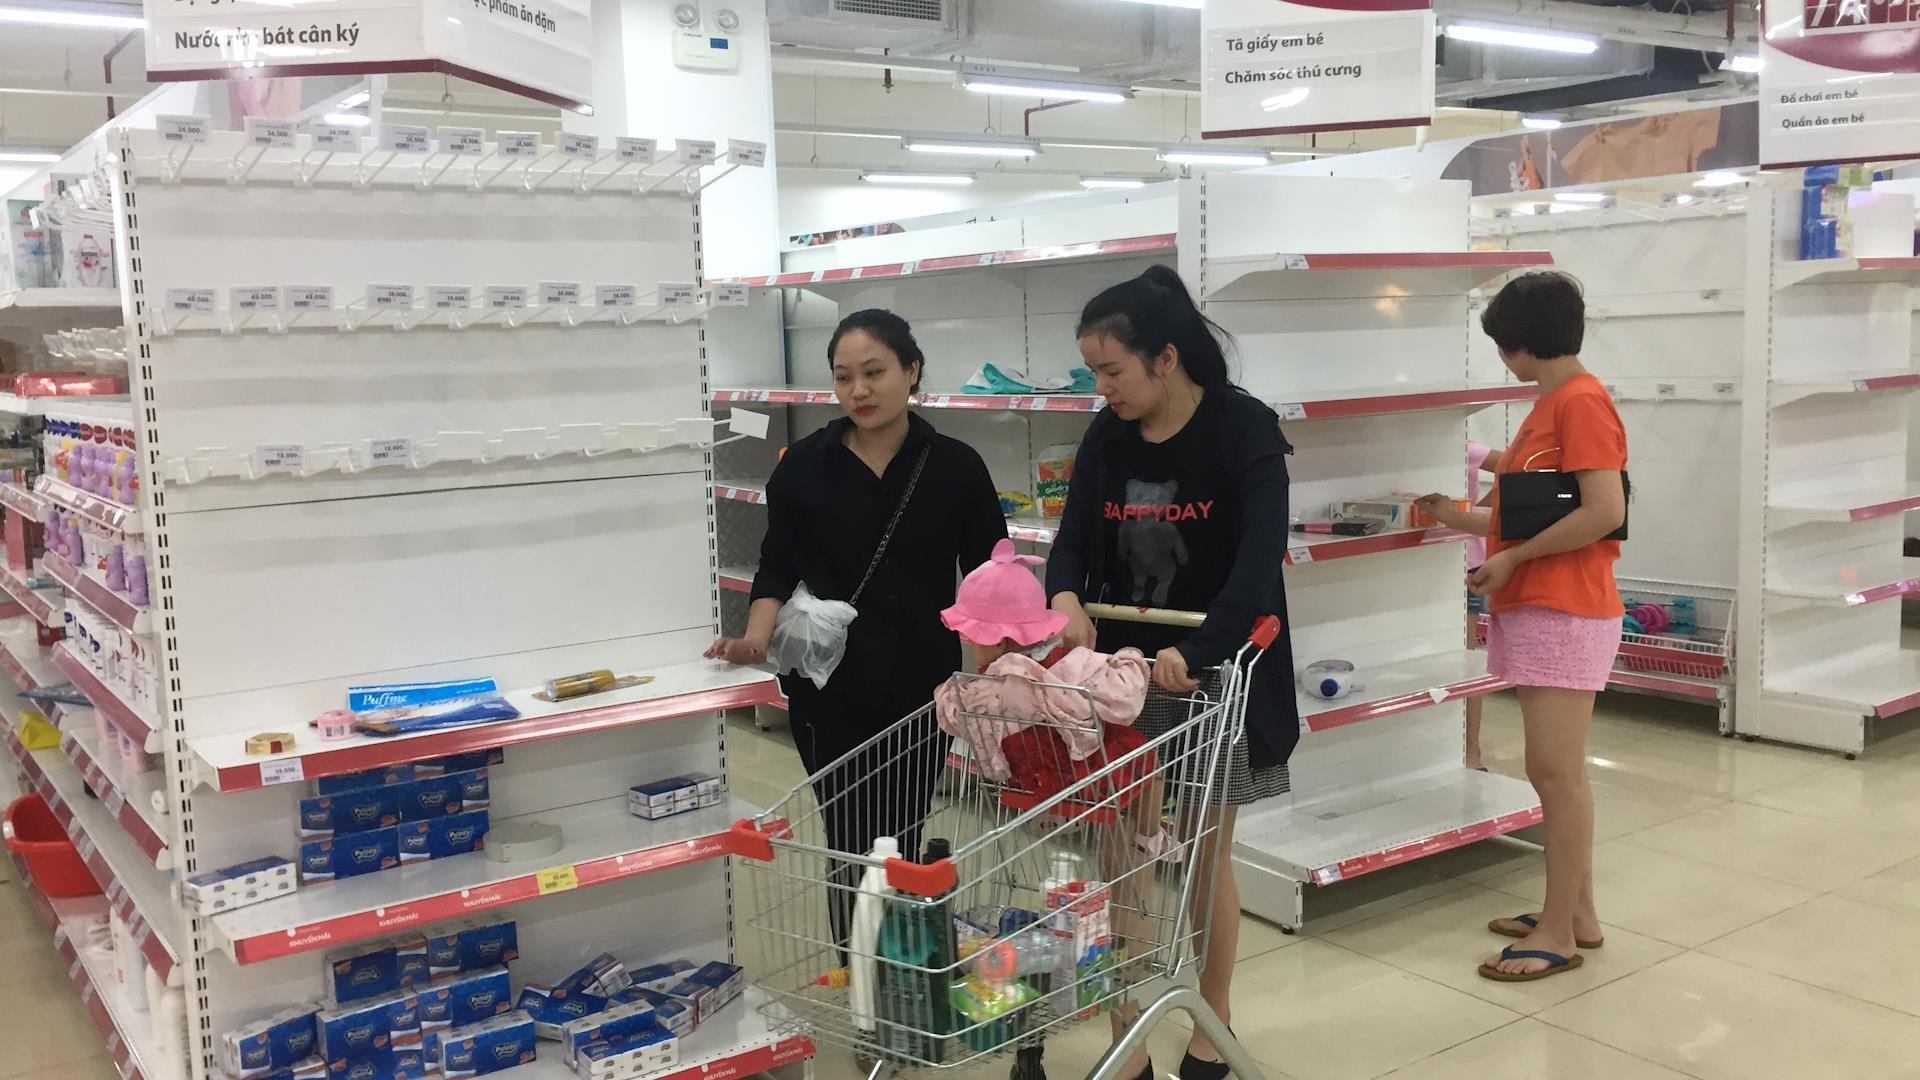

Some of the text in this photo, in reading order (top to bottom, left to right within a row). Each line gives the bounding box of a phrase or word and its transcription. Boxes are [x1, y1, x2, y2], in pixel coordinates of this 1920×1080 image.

[520, 4, 533, 24] ăn
[535, 9, 556, 33] dặm
[263, 26, 294, 45] bát
[299, 24, 332, 43] cân
[336, 22, 360, 47] ký
[1226, 32, 1324, 53] Tã giấy em bé
[1225, 64, 1362, 84] Chăm sóc thú cưng
[1825, 93, 1842, 101] em
[1844, 89, 1859, 99] bé
[1815, 115, 1829, 126] áo
[1831, 116, 1849, 125] em
[1851, 113, 1865, 123] bé
